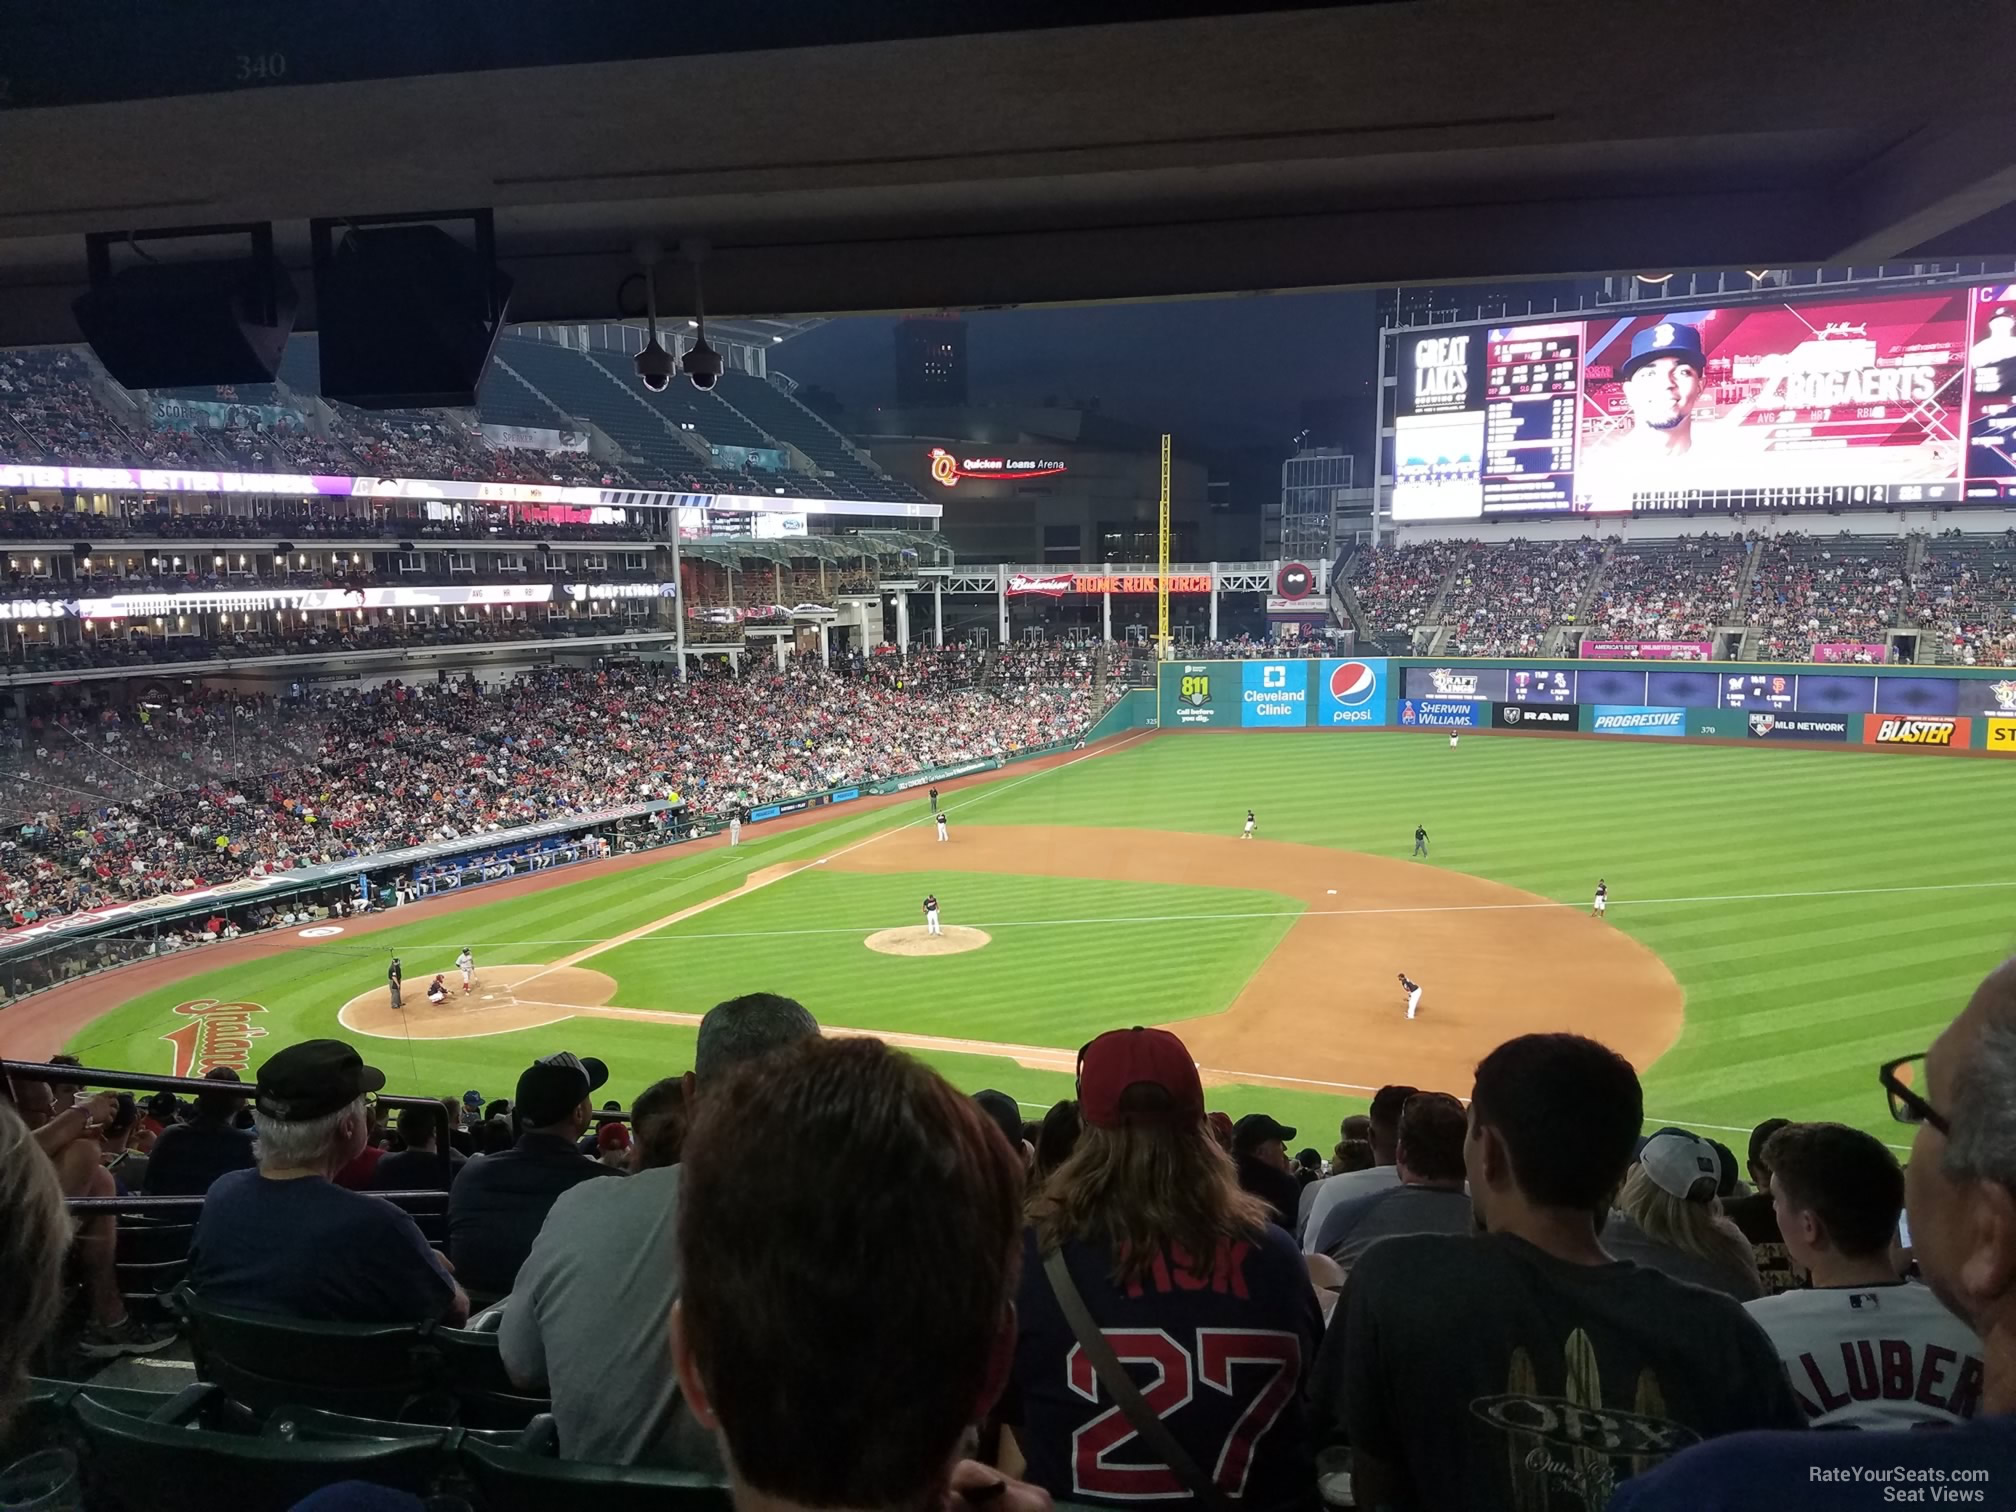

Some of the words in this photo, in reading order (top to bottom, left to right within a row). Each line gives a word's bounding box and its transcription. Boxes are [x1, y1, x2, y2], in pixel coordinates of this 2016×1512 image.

[236, 52, 286, 79] 340
[1415, 335, 1470, 369] GREAT
[1415, 365, 1468, 396] LAKES
[157, 403, 197, 419] SCORE
[1757, 412, 1775, 424] AVG
[1810, 410, 1823, 421] HR
[1857, 407, 1873, 419] RBI
[931, 454, 961, 486] Q
[963, 459, 1003, 470] Quicken
[1006, 459, 1036, 469] Loans
[1037, 460, 1065, 469] Arena
[1873, 486, 1884, 501] 2
[589, 583, 660, 599] DRAFTKINGS
[1010, 576, 1068, 591] Budweiser
[1075, 576, 1119, 592] HOME
[1123, 576, 1157, 592] RUN
[1181, 676, 1209, 696] 811
[1438, 676, 1476, 685] DRAFT
[1438, 684, 1475, 692] KINGS
[1244, 690, 1305, 702] Cleveland
[1257, 704, 1292, 716] Clinic
[1419, 701, 1471, 714] SHERWIN
[1333, 709, 1371, 722] pepsi
[1418, 712, 1473, 726] WILLIAMS.
[1524, 711, 1570, 722] RAM
[1594, 712, 1684, 729] PROGRESSIVE
[1751, 714, 1773, 724] MLB
[1700, 726, 1716, 734] 370
[1775, 722, 1796, 730] MLB
[1797, 722, 1845, 732] NETWORK
[1876, 720, 1955, 745] BLASTER
[1994, 728, 2016, 741] ST
[1786, 1339, 1984, 1421] LUBER
[1067, 1328, 1299, 1498] 27
[1487, 1399, 1680, 1450] OBX
